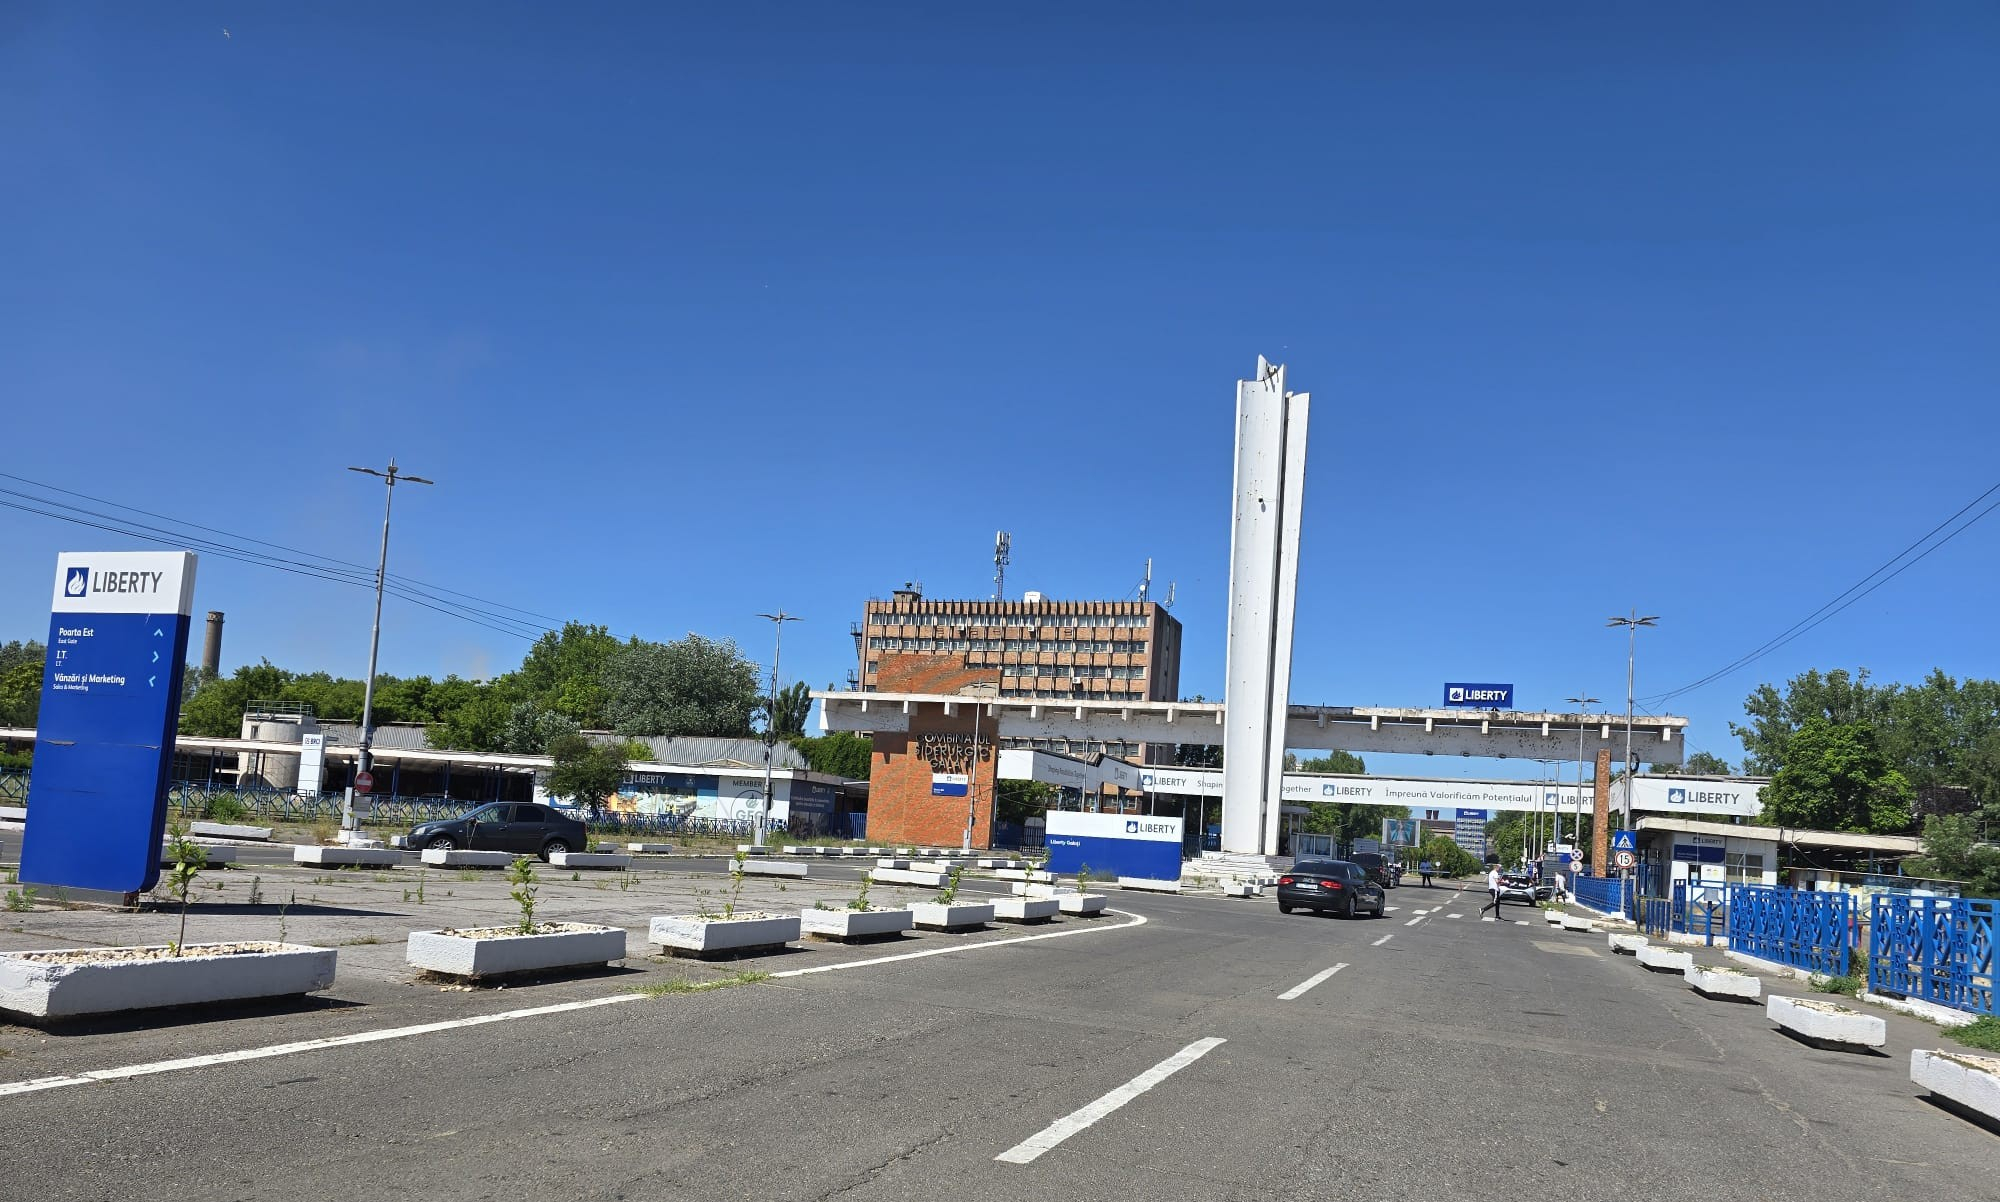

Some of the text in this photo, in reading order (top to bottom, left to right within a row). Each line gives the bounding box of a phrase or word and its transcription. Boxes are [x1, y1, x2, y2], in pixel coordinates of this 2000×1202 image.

[92, 571, 163, 593] LIBERTY
[59, 627, 94, 637] Poarta Est
[54, 672, 80, 682] Vânzări
[88, 674, 126, 686] Marketing
[1465, 689, 1508, 701] LIBERTY
[915, 745, 989, 757] SIDERURGC
[634, 774, 666, 785] LIBERTY
[732, 780, 763, 788] MEMBER
[1154, 776, 1187, 787] LIBERTY
[1197, 779, 1223, 790] Shapin
[1280, 784, 1312, 794] ogether
[1336, 786, 1373, 797] LIBERTY
[1385, 788, 1532, 804] Împreună Valorificăm Potențialul
[1688, 791, 1741, 805] LIBERTY
[1140, 823, 1176, 834] LIBERTY
[1619, 855, 1630, 865] 15
